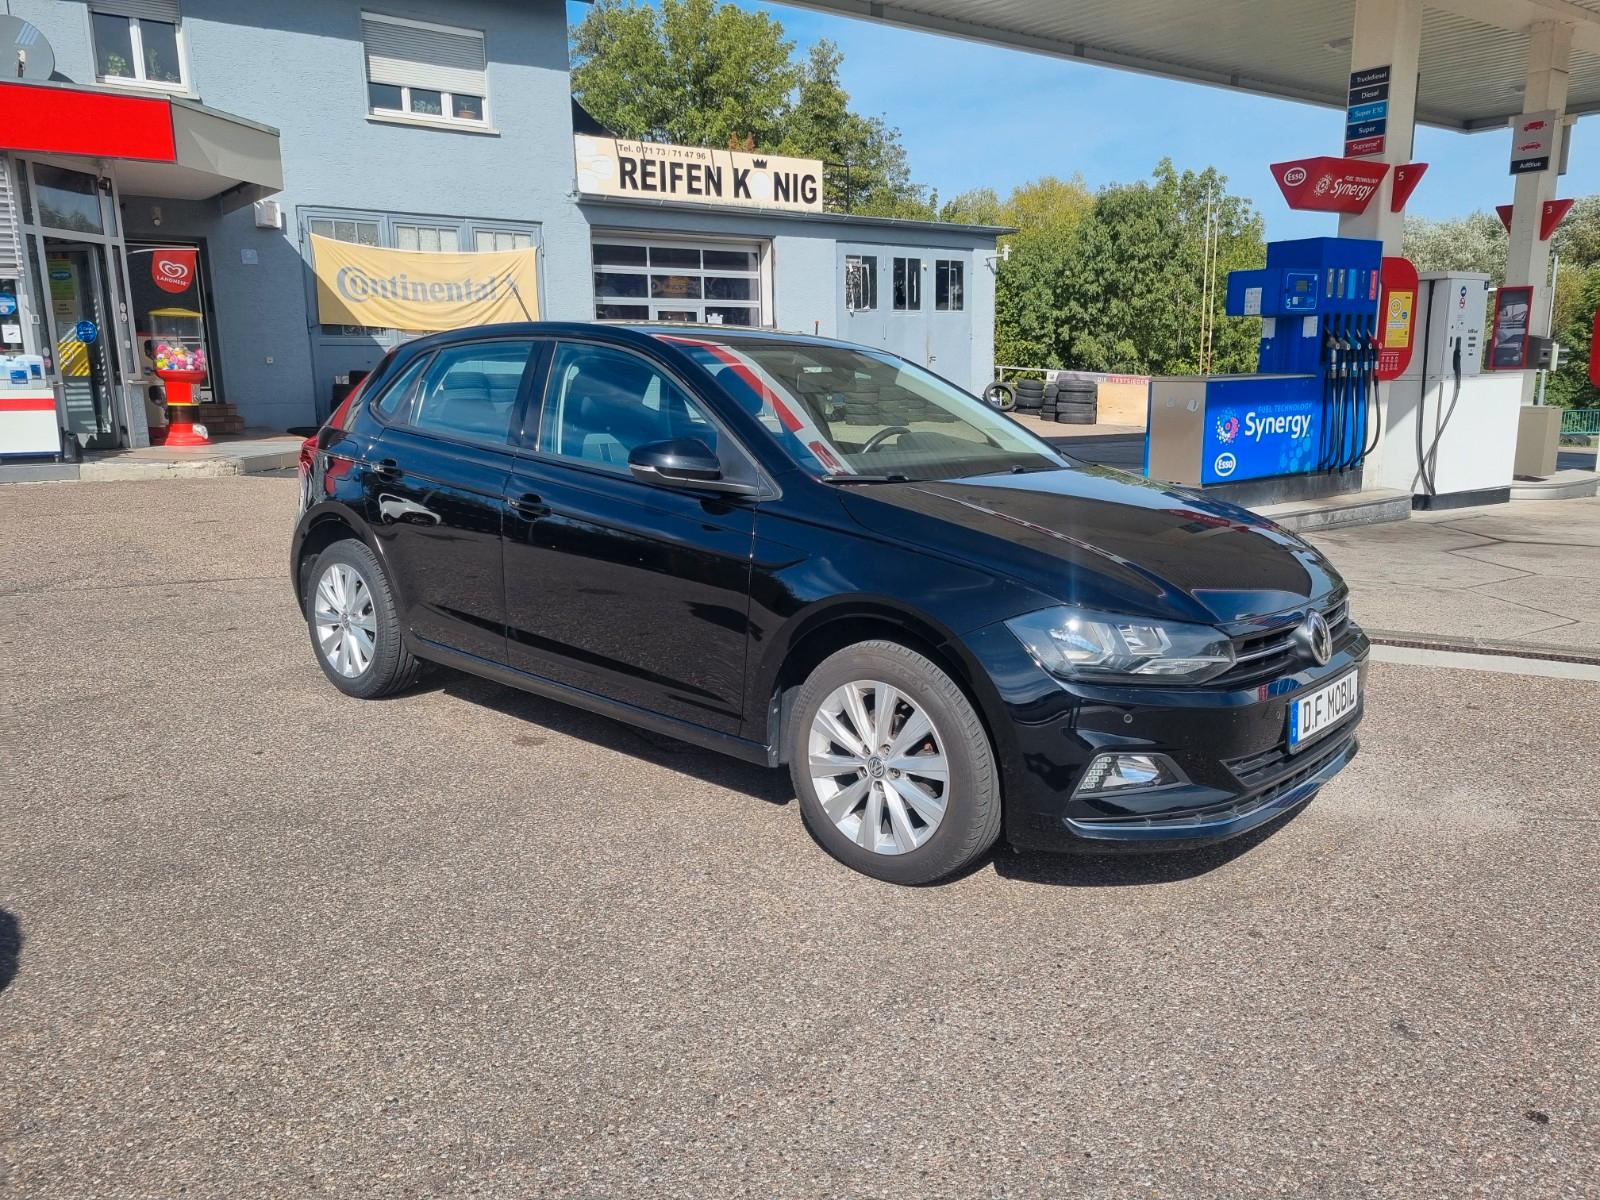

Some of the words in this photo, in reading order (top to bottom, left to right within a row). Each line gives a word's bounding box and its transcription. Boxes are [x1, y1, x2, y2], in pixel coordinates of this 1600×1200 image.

[1361, 89, 1380, 99] Diesel
[1354, 110, 1372, 118] Super
[1358, 126, 1376, 135] Super
[618, 144, 634, 153] Tel.
[656, 148, 666, 156] 73
[672, 149, 682, 157] 71
[684, 151, 694, 159] 47
[696, 152, 706, 160] 96
[619, 157, 722, 197] REIFEN
[1398, 171, 1405, 181] 5
[1330, 178, 1375, 201] Synergy
[1544, 205, 1553, 215] 3
[336, 266, 497, 303] Continental
[1258, 405, 1273, 413] FUEL
[1274, 402, 1313, 412] TECHNOLOGY
[1244, 411, 1312, 443] Synergy
[1217, 459, 1234, 470] Esso
